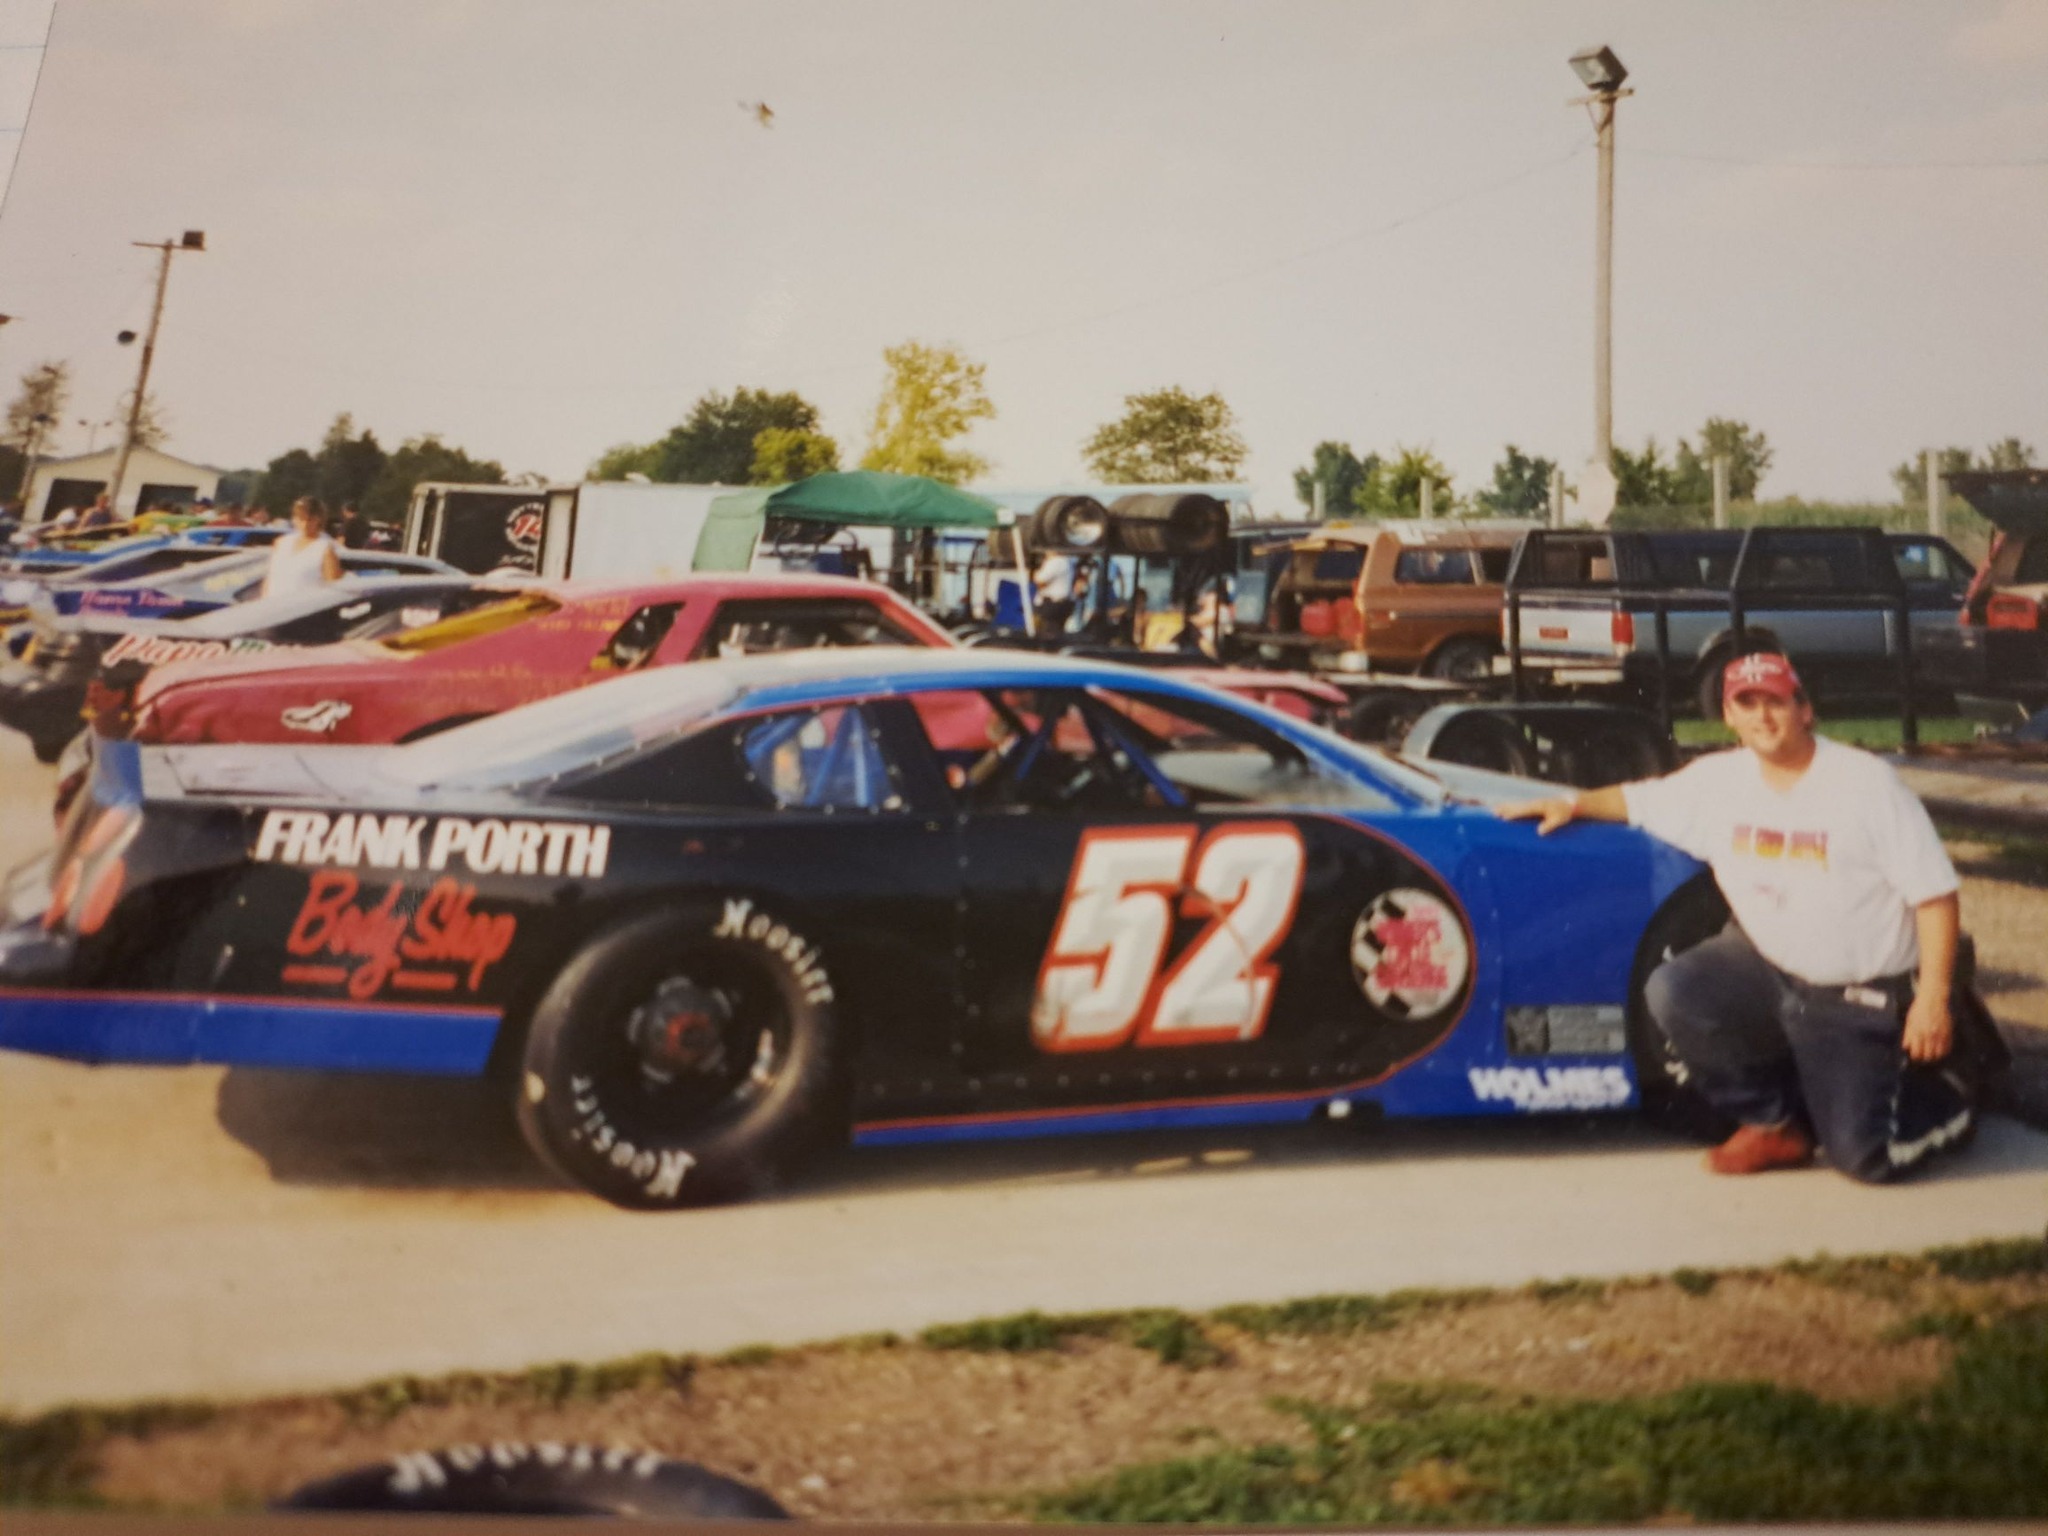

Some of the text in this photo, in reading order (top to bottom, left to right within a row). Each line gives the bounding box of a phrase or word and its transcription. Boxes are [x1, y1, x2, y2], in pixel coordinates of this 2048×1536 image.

[254, 809, 611, 878] FRANK PORTH
[287, 868, 517, 1000] Body Shop
[713, 897, 835, 1004] Hoosier
[1030, 819, 1307, 1054] 52
